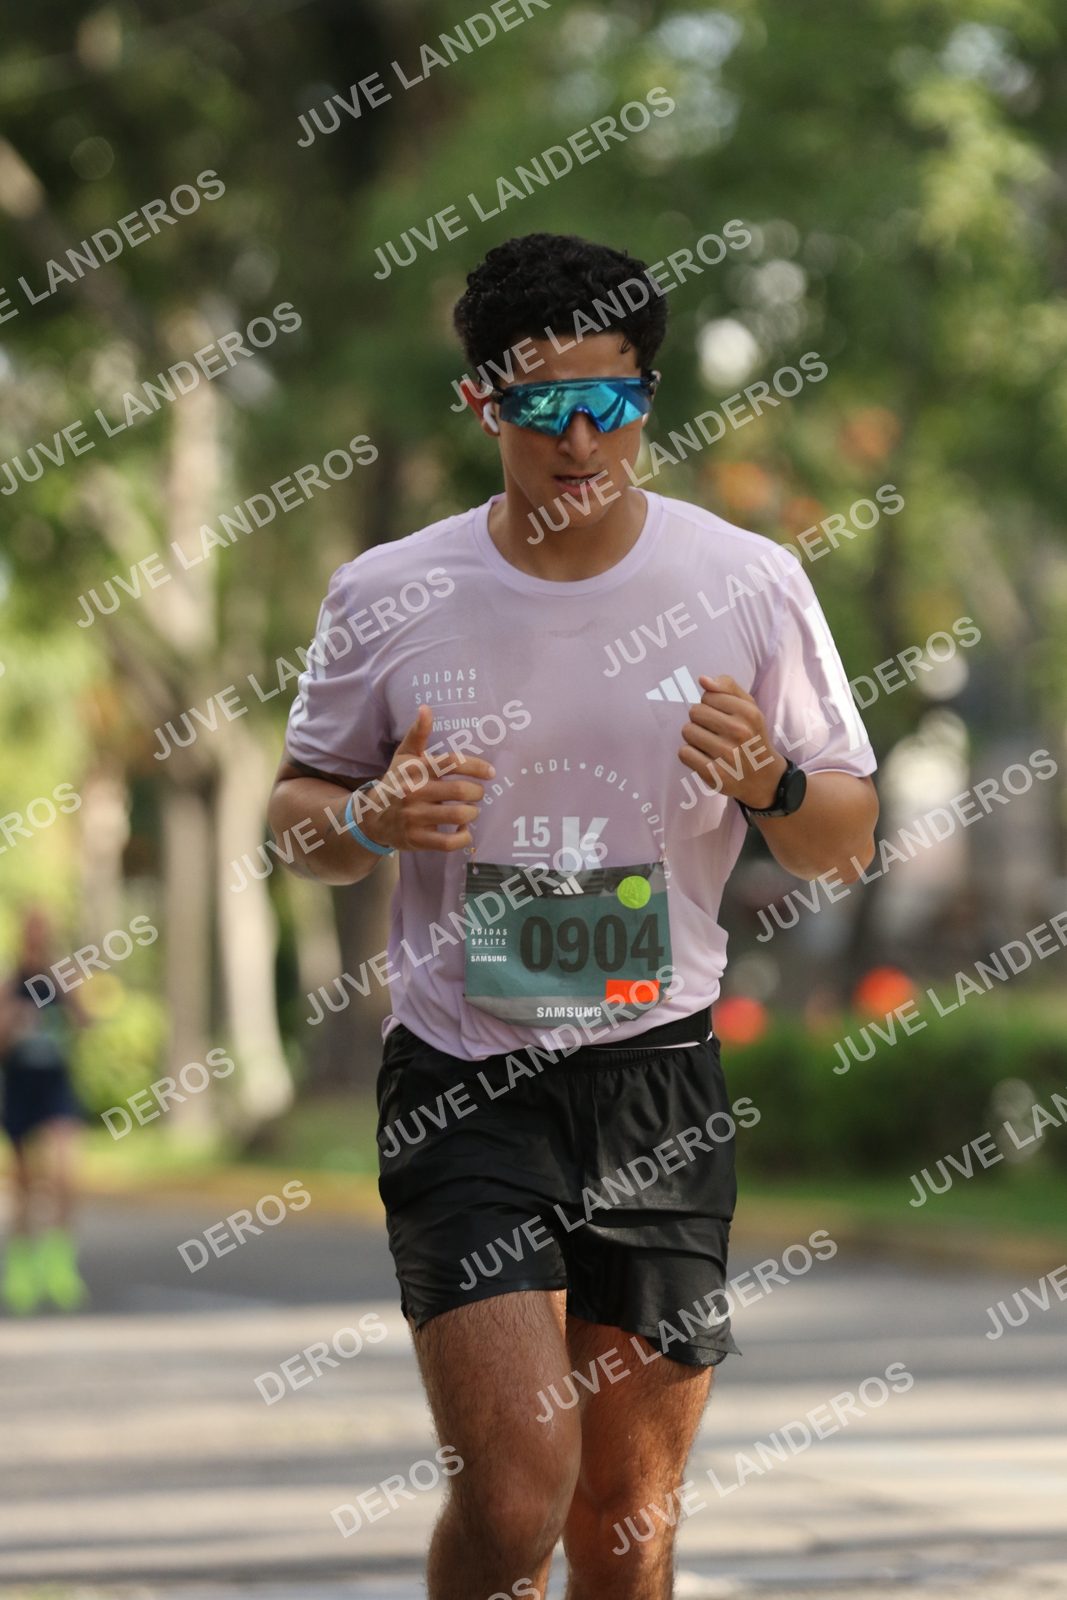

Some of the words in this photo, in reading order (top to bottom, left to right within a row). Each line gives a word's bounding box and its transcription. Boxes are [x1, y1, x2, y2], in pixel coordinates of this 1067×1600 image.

[412, 668, 476, 687] ADIDAS
[415, 687, 475, 705] SPLITS
[432, 716, 480, 732] MSUNG
[483, 776, 514, 805] GDL
[534, 758, 570, 774] GDL
[594, 765, 628, 791] GDL
[641, 802, 664, 836] GDL
[512, 816, 550, 848] 15
[562, 816, 609, 870] K
[470, 928, 508, 936] ADIDAS
[471, 938, 506, 946] SPLITS
[519, 914, 665, 973] 0904
[536, 1006, 602, 1018] SAMSUNG
